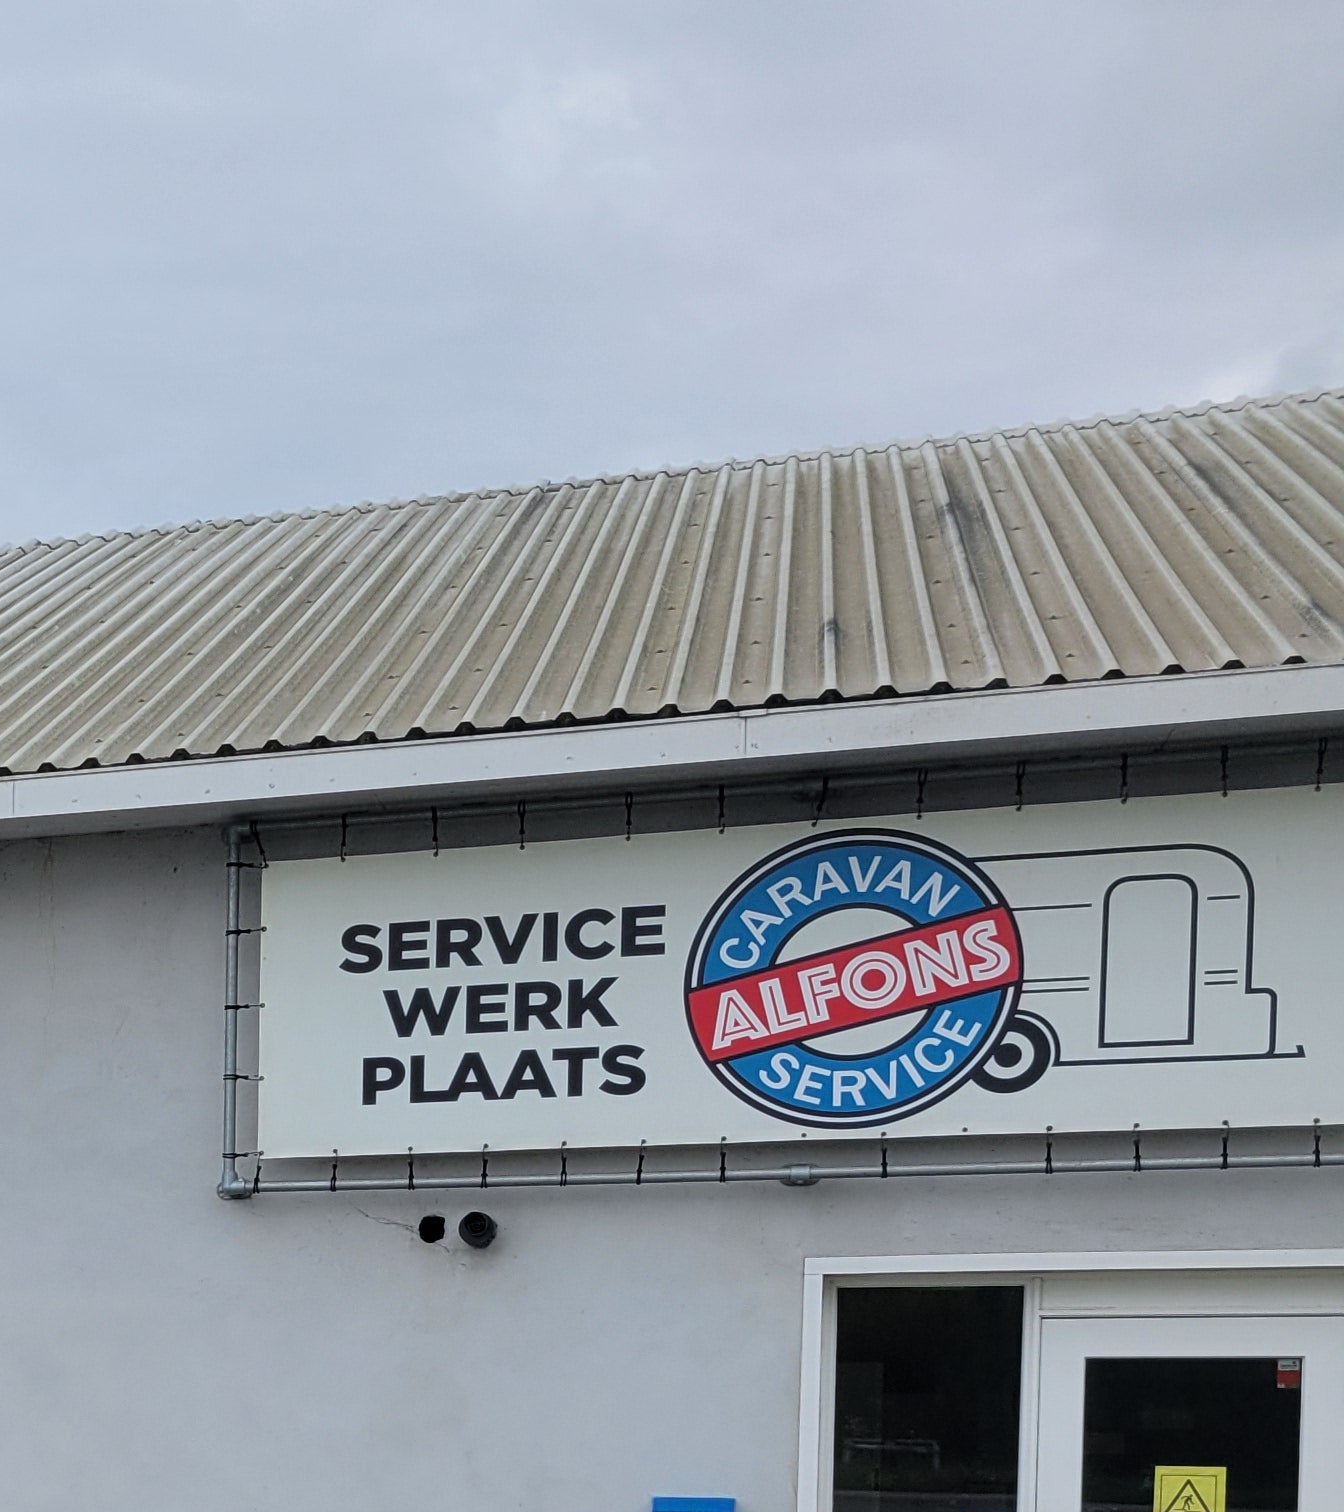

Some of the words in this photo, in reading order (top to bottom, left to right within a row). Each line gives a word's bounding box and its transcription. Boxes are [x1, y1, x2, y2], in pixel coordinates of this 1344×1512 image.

[339, 904, 666, 974] SERVICE
[719, 855, 961, 969] CARAVAN
[382, 976, 620, 1038] WERK
[711, 919, 1012, 1052] ALFONS
[361, 1044, 647, 1106] PLAATS
[758, 1008, 983, 1108] SERVICE
